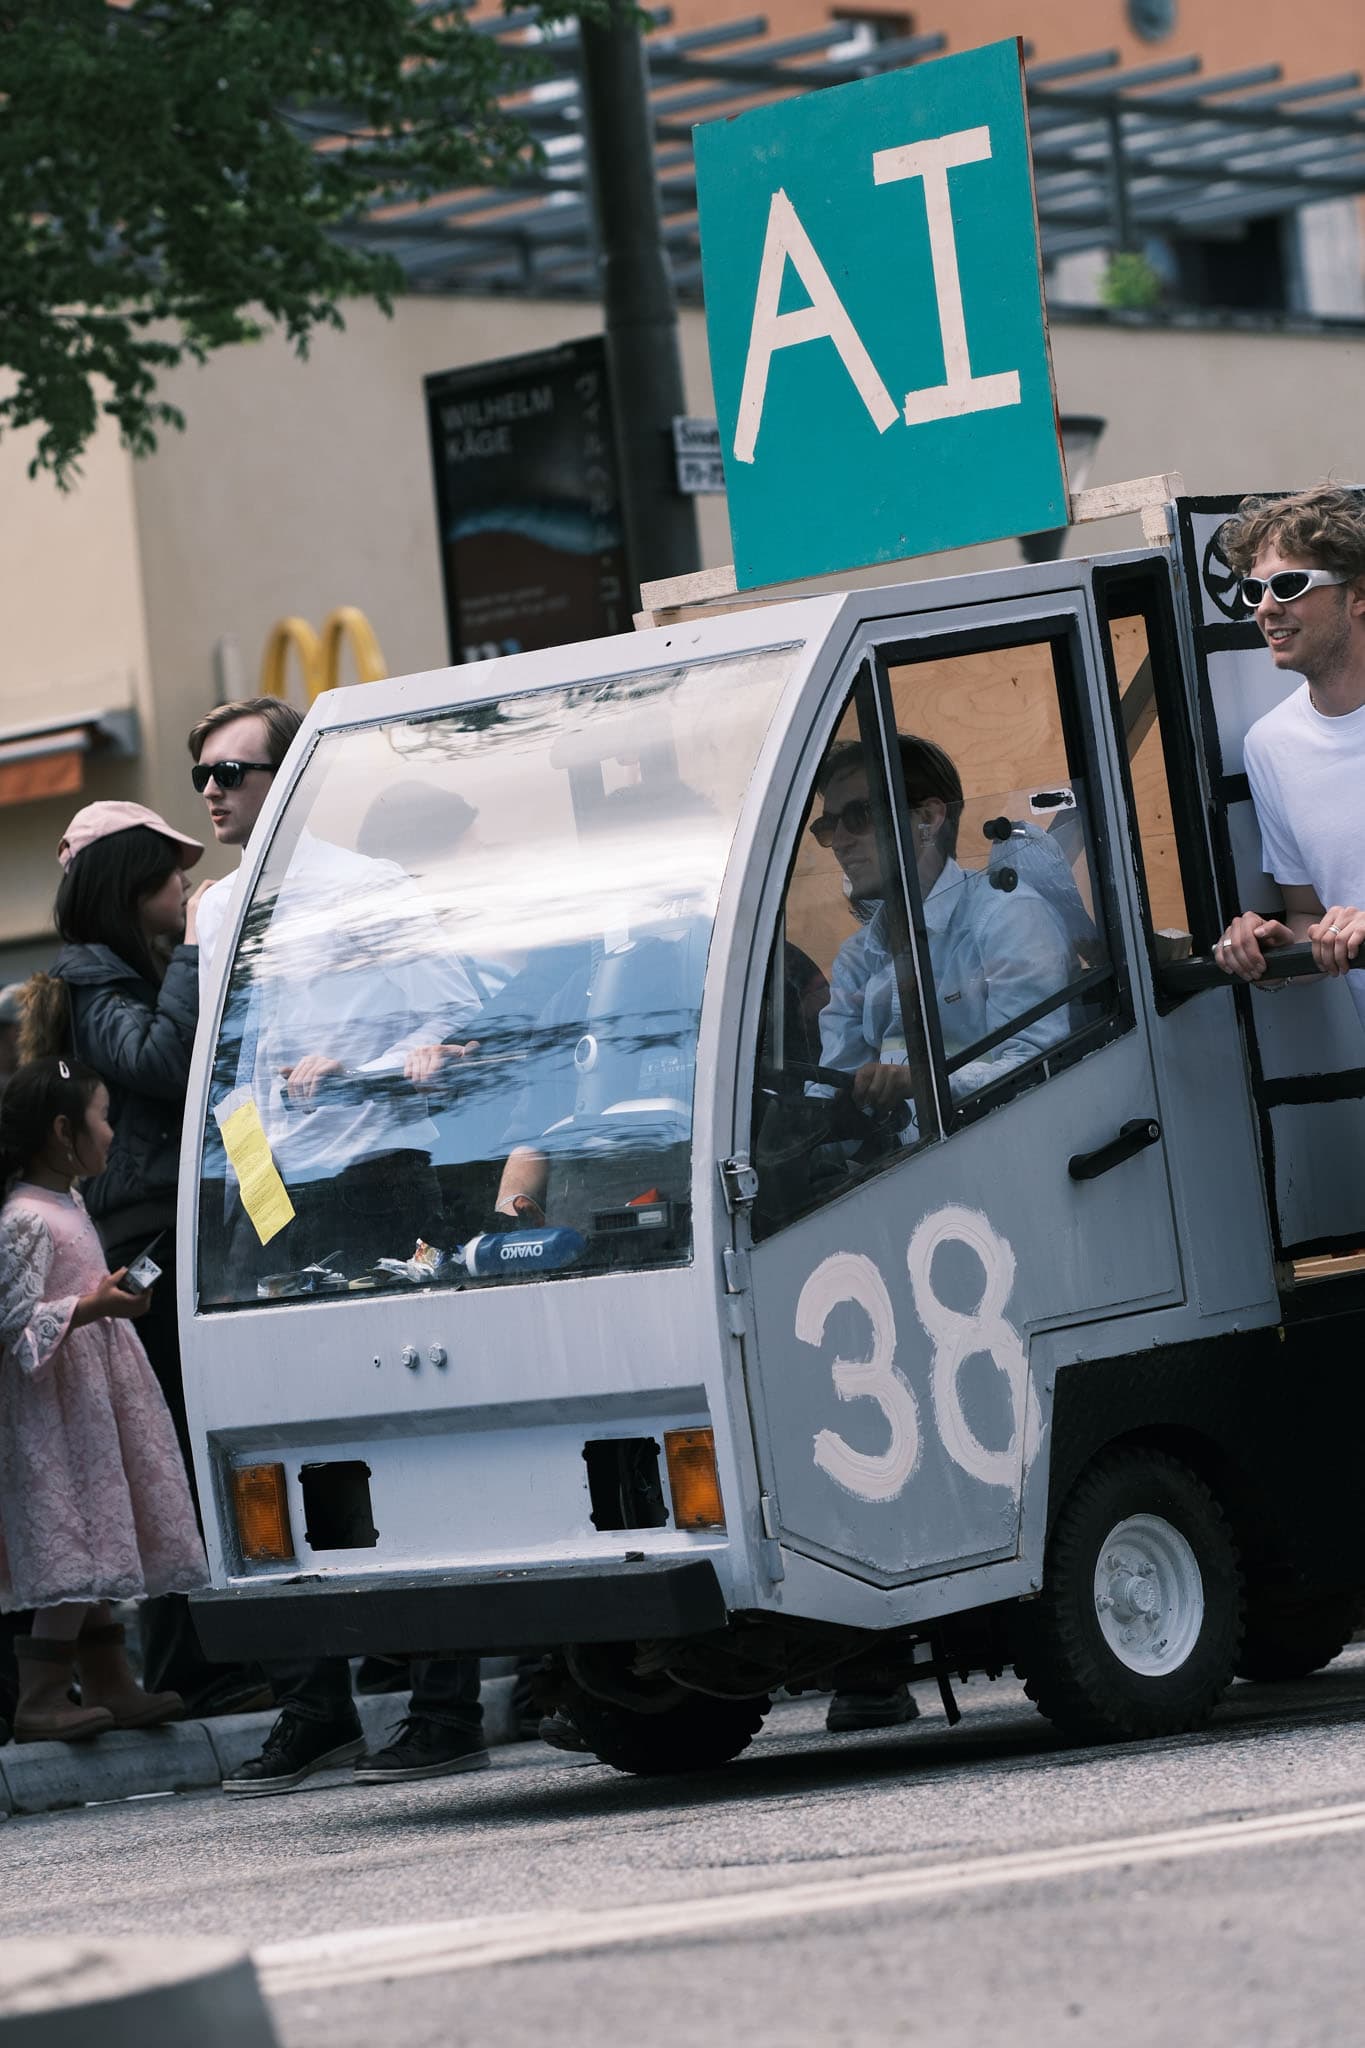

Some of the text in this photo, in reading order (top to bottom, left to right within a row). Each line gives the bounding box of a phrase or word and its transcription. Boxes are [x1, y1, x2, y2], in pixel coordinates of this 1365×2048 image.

[733, 125, 1021, 465] AI
[441, 385, 553, 430] WILHELM
[445, 425, 513, 463] KÅGE
[500, 1244, 543, 1260] OVAKO
[795, 1202, 1047, 1502] 38
